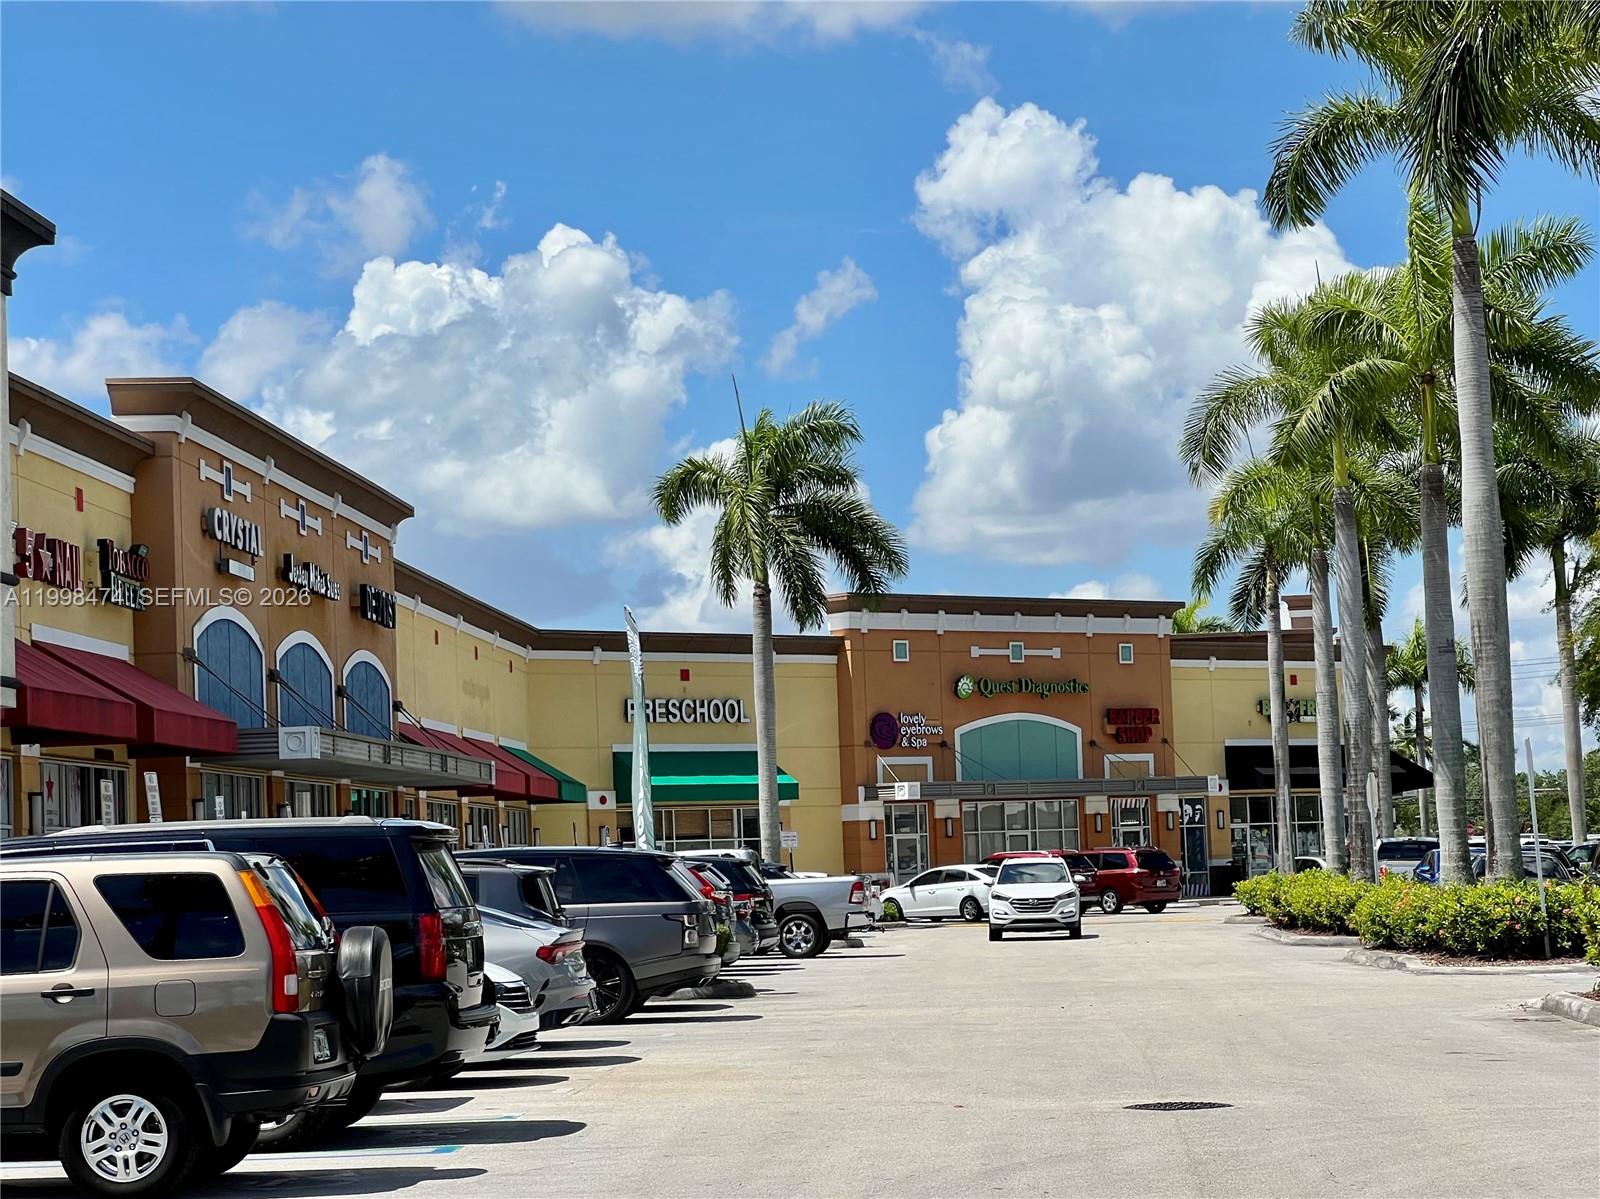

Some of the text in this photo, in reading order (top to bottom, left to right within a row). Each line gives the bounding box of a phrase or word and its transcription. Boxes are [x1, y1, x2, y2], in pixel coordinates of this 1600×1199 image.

[214, 507, 264, 557] CRYSTAL
[106, 539, 150, 582] TOBACCO
[979, 677, 1090, 699] Quest Diagnostics
[625, 698, 751, 724] PRESCHOOL
[900, 713, 927, 727] lovely
[1106, 708, 1161, 725] BARBER
[900, 724, 943, 737] eyebrows
[1115, 726, 1153, 744] SHOP
[901, 737, 928, 750] & Spa
